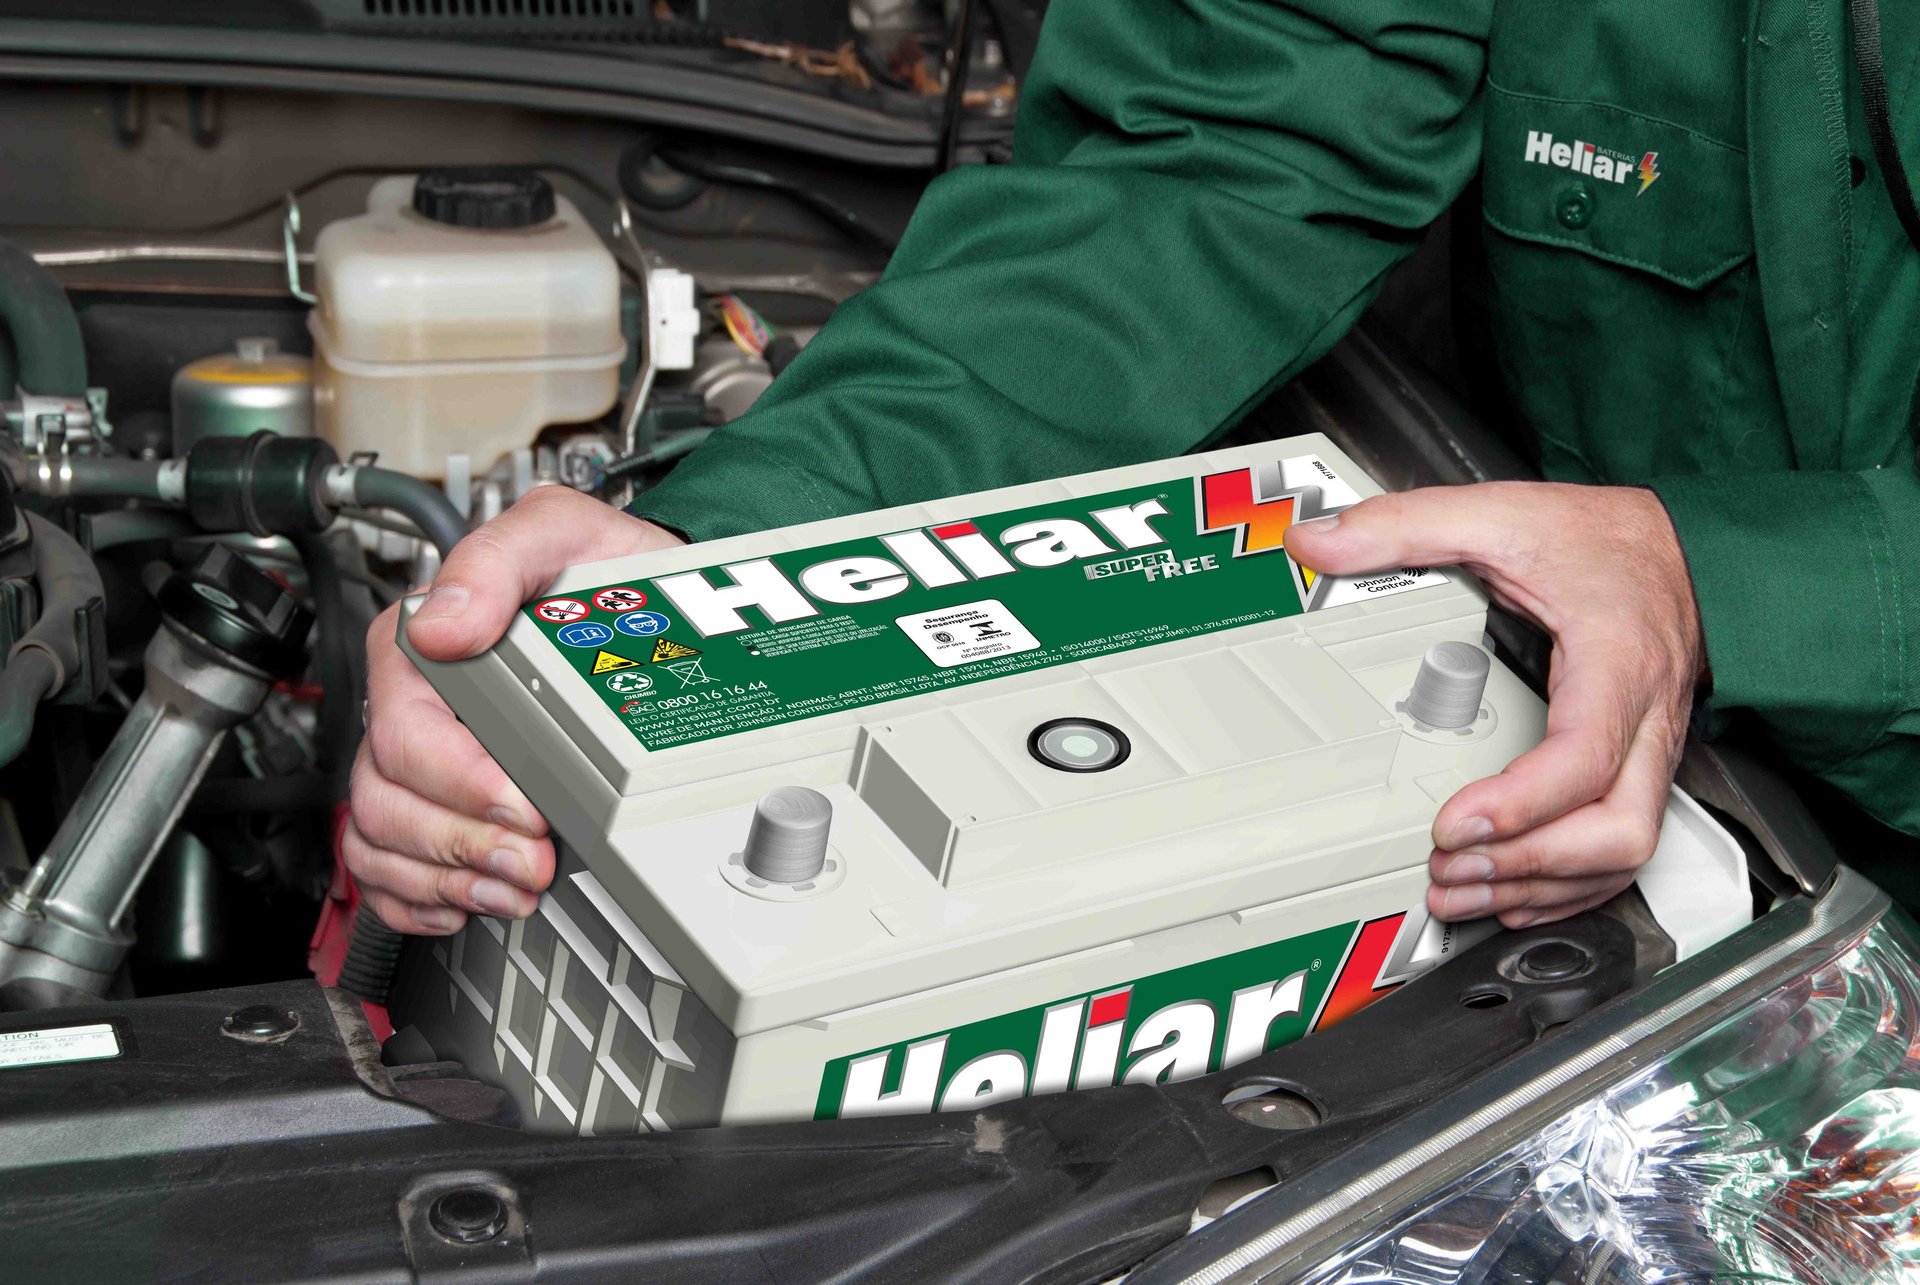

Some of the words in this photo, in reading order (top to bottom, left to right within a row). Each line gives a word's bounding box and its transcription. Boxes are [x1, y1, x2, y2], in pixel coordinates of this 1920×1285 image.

[1524, 130, 1633, 184] Heliar
[1598, 146, 1635, 163] BATERIAS
[650, 497, 1173, 639] Heliar
[1094, 552, 1169, 578] SUPER
[1144, 554, 1220, 582] FREE
[1354, 576, 1400, 590] Johnson
[1368, 579, 1415, 592] Controls
[923, 614, 988, 629] Desempenho
[925, 610, 978, 624] Segurança
[974, 642, 1002, 651] Registro
[975, 632, 1011, 642] INMETRO
[641, 729, 675, 740] LIVRE
[695, 707, 774, 729] MANUTENÇÃO
[786, 695, 836, 710] NORMAS
[839, 688, 872, 699] ABNT:
[873, 682, 898, 691] NBR
[899, 675, 932, 686] 15745,
[934, 670, 958, 679] NBR
[959, 663, 992, 675] 15914,
[992, 658, 1018, 668] NBR
[1018, 651, 1047, 661] 15940
[1061, 637, 1107, 652] ISO14000
[1113, 625, 1169, 641] ISOTS16949
[648, 728, 710, 747] FABRICADO
[713, 724, 734, 733] POR
[736, 713, 786, 729] JOHNSON
[788, 701, 843, 718] CONTROLS
[876, 686, 913, 699] BRASIL
[960, 659, 1041, 681] INDEPENDÊNCIA
[1042, 655, 1063, 664] 2747
[1070, 638, 1137, 658] SOROCABA/SP
[1193, 609, 1276, 632] 01.376.079/0001-12
[625, 690, 657, 700] CHUMBO
[629, 704, 655, 714] SAC
[658, 695, 698, 710] 0800
[700, 690, 722, 700] 16
[723, 685, 745, 696] 16
[749, 681, 768, 691] 44
[629, 717, 650, 725] LEIA
[661, 702, 715, 718] CERTIFICADO
[730, 691, 775, 704] GARANTIA
[635, 697, 780, 732] www.heliar.com.br
